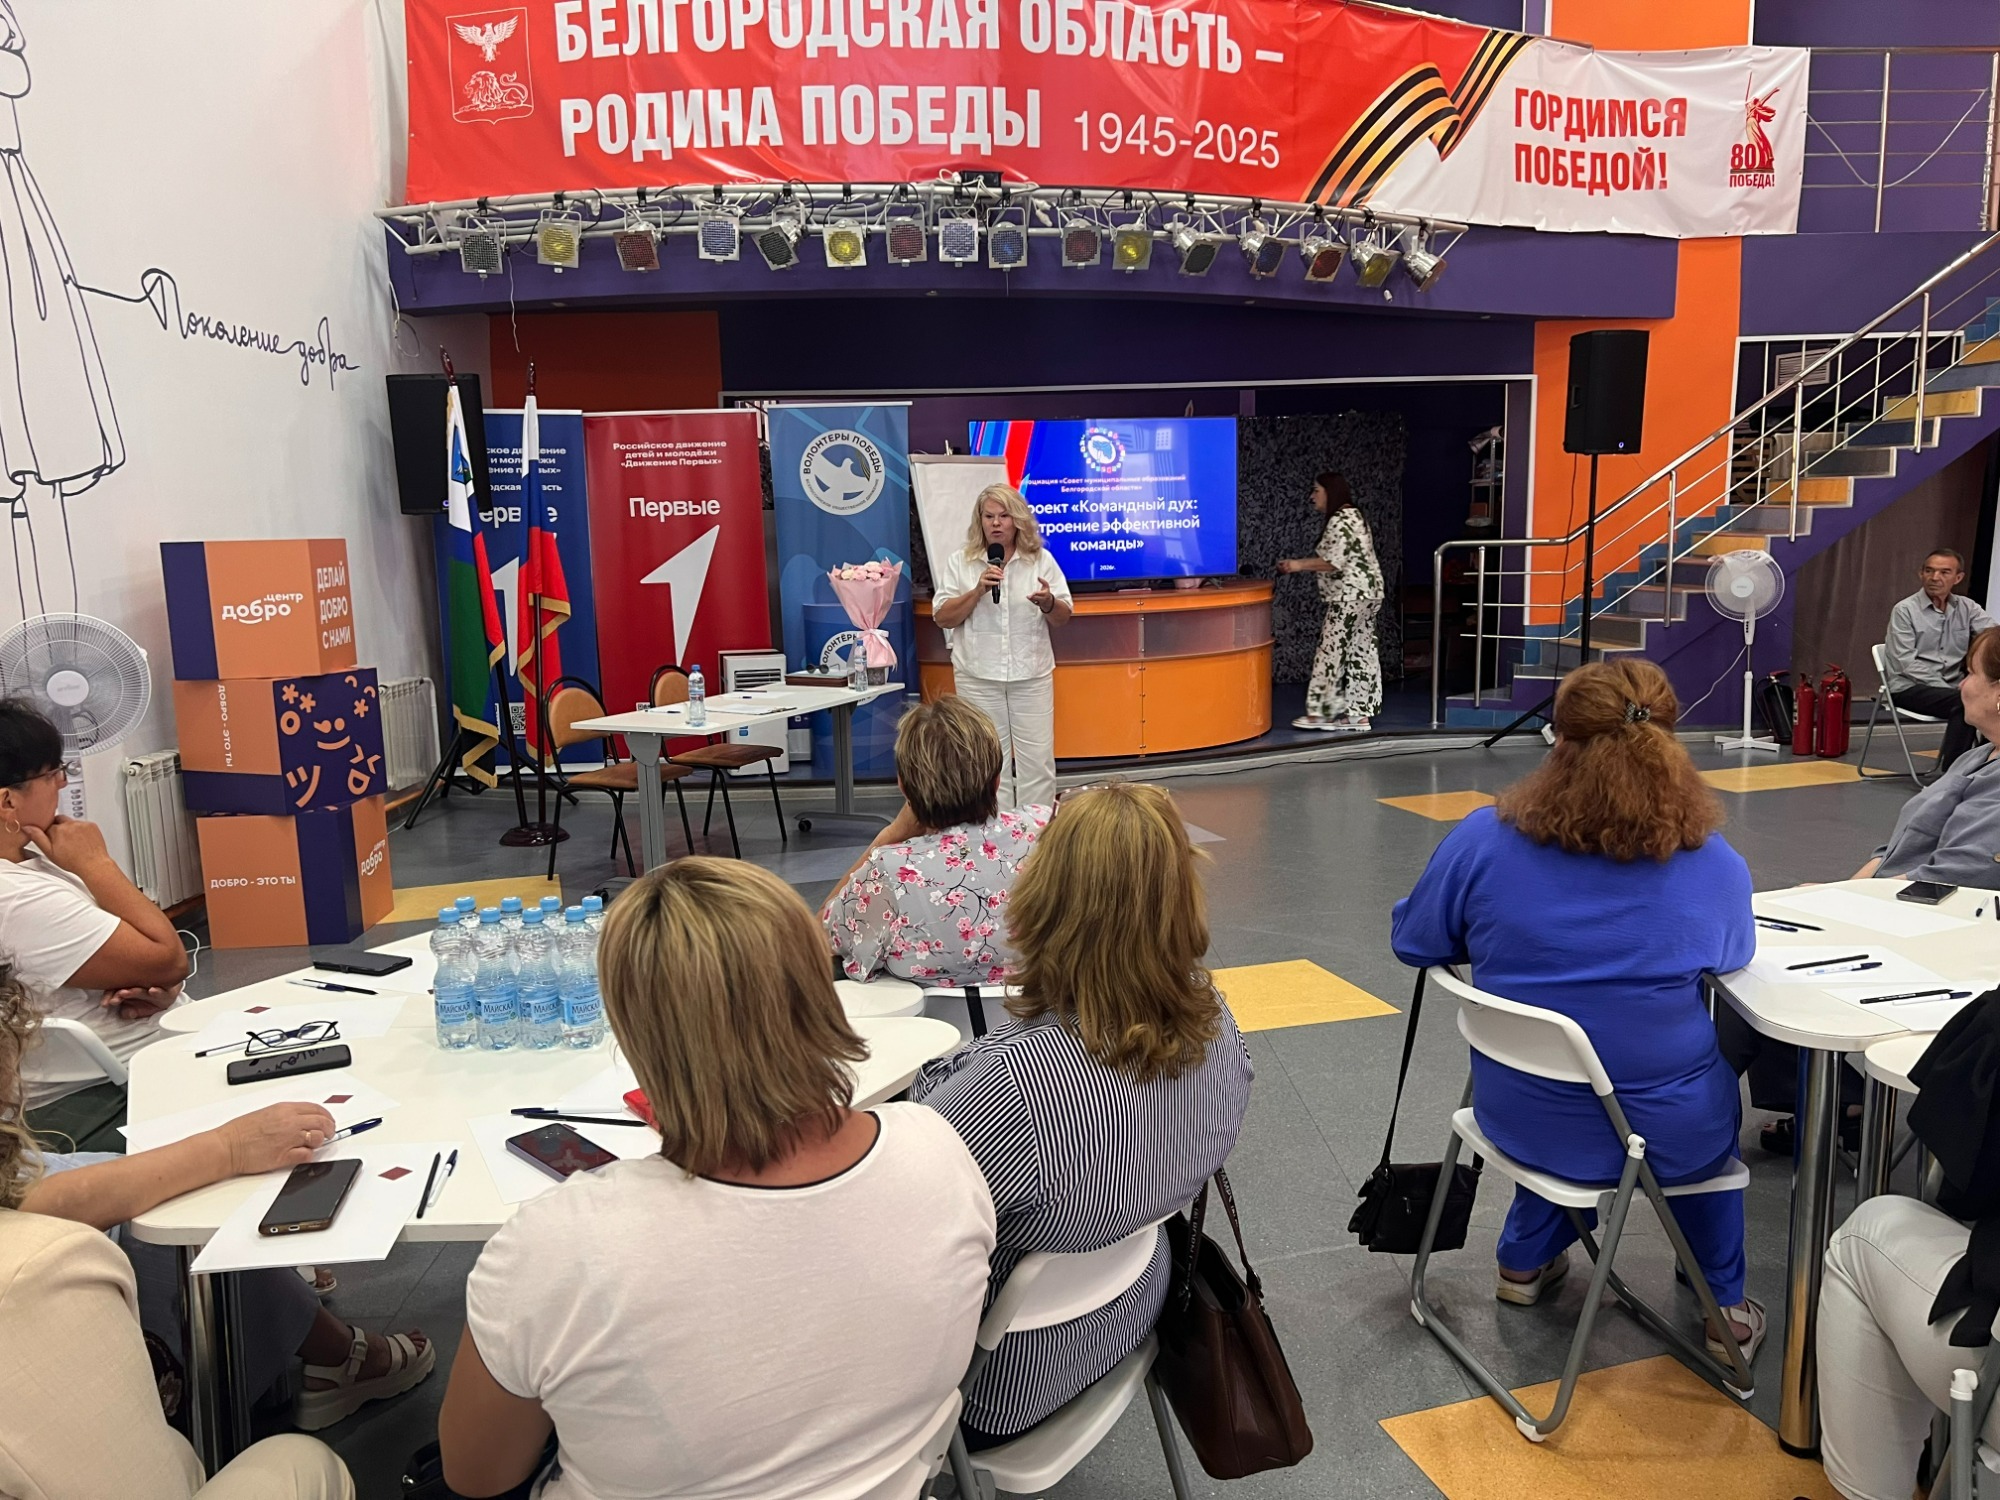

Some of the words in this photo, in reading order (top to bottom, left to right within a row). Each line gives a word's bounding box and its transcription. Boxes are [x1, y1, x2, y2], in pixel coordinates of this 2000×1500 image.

[554, 0, 1000, 63] БЕЛГОРОДСКАЯ
[1019, 0, 1242, 74] ОБЛАСТЬ
[560, 86, 784, 163] РОДИНА
[801, 84, 1041, 156] ПОБЕДЫ
[1514, 87, 1688, 143] ГОРДИМСЯ
[1074, 110, 1280, 169] 1945-2025
[1730, 143, 1757, 170] 80
[1514, 143, 1668, 197] ПОБЕДОЙ!
[1729, 173, 1775, 189] ПОБЕДА!
[141, 268, 286, 355] Поколение
[298, 316, 361, 391] добра
[612, 441, 674, 451] Российское
[675, 440, 727, 449] движение
[625, 450, 655, 460] детей
[664, 449, 717, 458] молодёжи
[851, 435, 882, 474] ПОБЕДЫ
[621, 459, 678, 468] «Движение
[679, 458, 722, 467] Первых»
[1061, 485, 1110, 494] Белгородской
[629, 497, 721, 523] Первые
[1071, 496, 1166, 514] «Командный
[1168, 499, 1198, 513] дух:
[1102, 514, 1201, 534] эффективной
[1070, 538, 1145, 552] команды»
[316, 561, 346, 593] ДЕЛАЙ
[221, 599, 291, 621] добро
[320, 595, 348, 625] ДОБРО
[322, 631, 330, 650] С
[329, 625, 352, 648] НАМИ
[217, 684, 229, 722] ДОБРО
[222, 729, 231, 751] ЭТО
[225, 752, 233, 767] ТЫ
[361, 850, 383, 876] добро
[210, 878, 249, 889] ДОБРО
[256, 877, 279, 886] ЭТО
[281, 876, 296, 885] ТЫ
